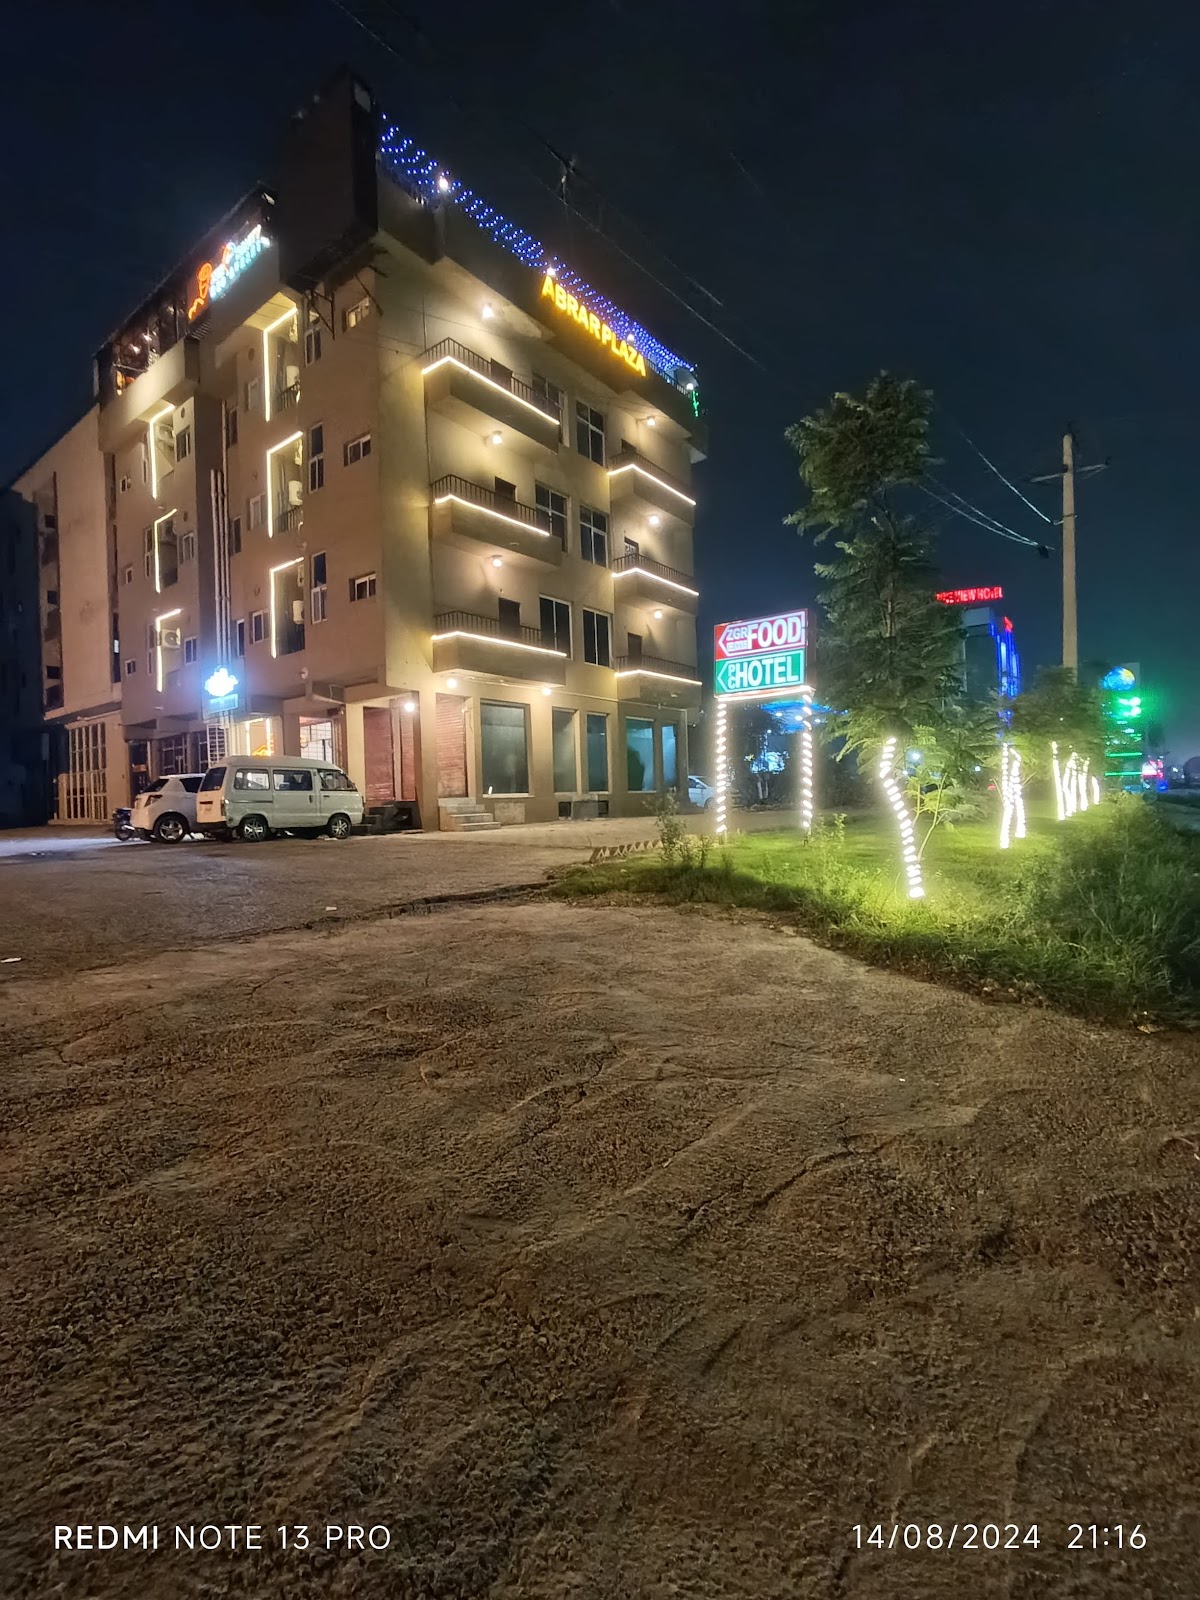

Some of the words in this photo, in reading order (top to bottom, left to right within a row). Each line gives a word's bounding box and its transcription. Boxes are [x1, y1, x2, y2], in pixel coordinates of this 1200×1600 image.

[541, 275, 601, 340] ABRAR
[602, 323, 646, 377] PLAZA
[747, 616, 801, 650] FOOD
[735, 656, 799, 689] HOTEL
